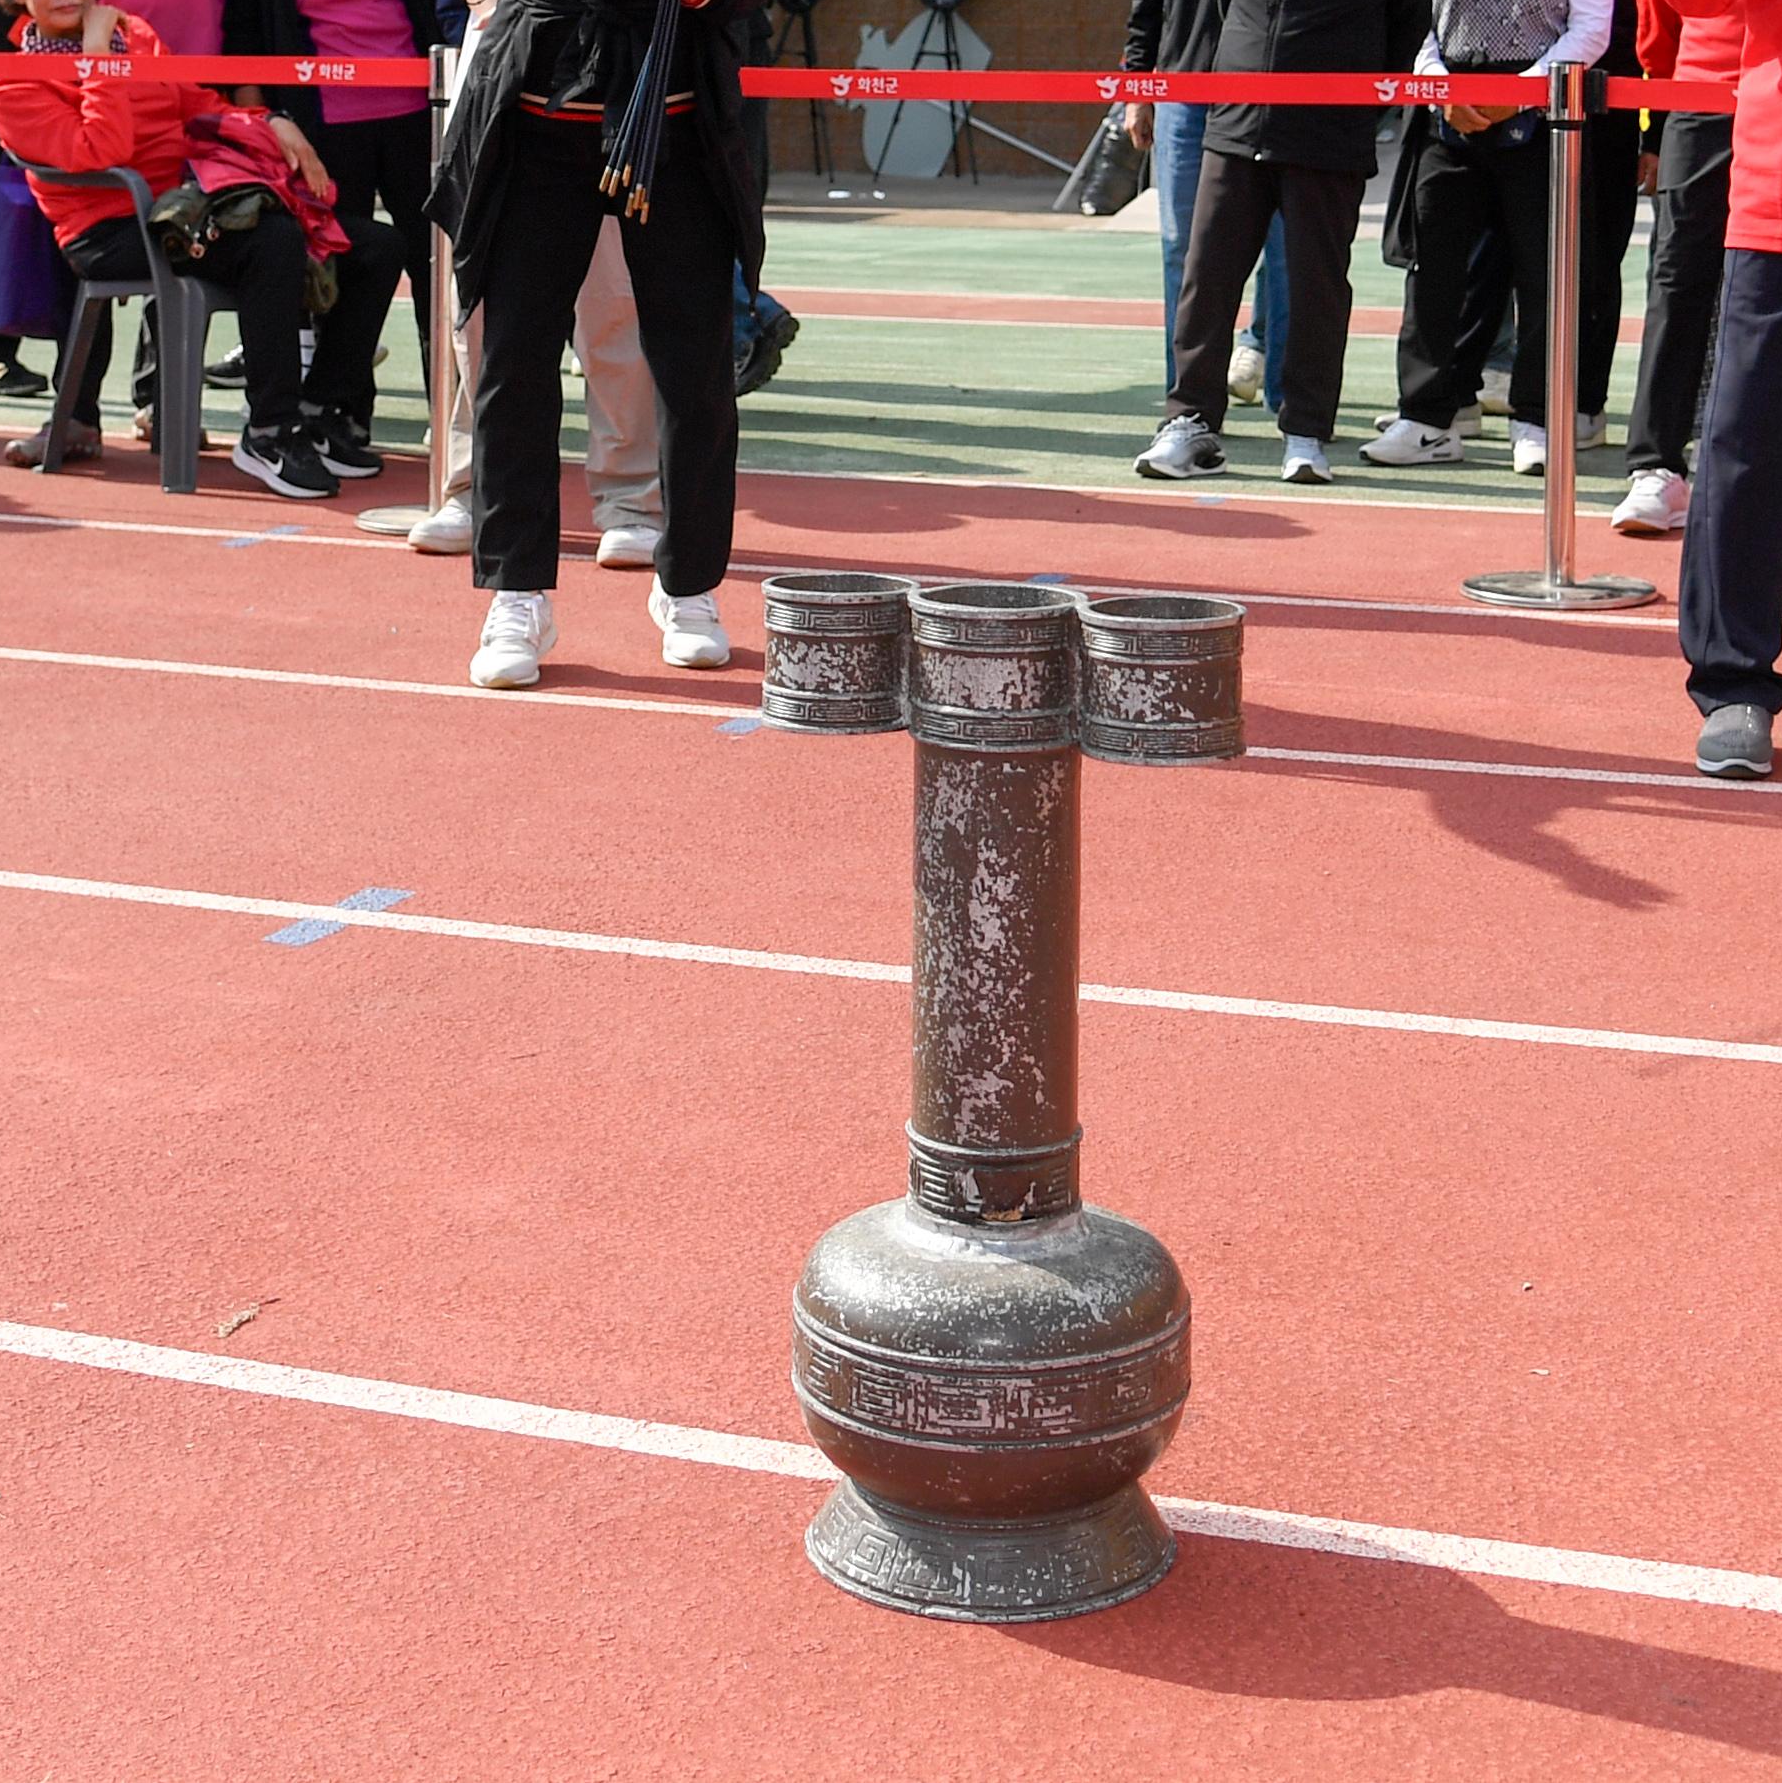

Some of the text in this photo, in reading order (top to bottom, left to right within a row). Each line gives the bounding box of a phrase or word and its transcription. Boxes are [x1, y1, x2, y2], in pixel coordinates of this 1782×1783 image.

[97, 58, 133, 77] 화천군
[319, 62, 356, 81] 화천군
[857, 76, 899, 95] 화천군
[1124, 78, 1169, 97] 화천군
[1404, 79, 1450, 100] 화천군
